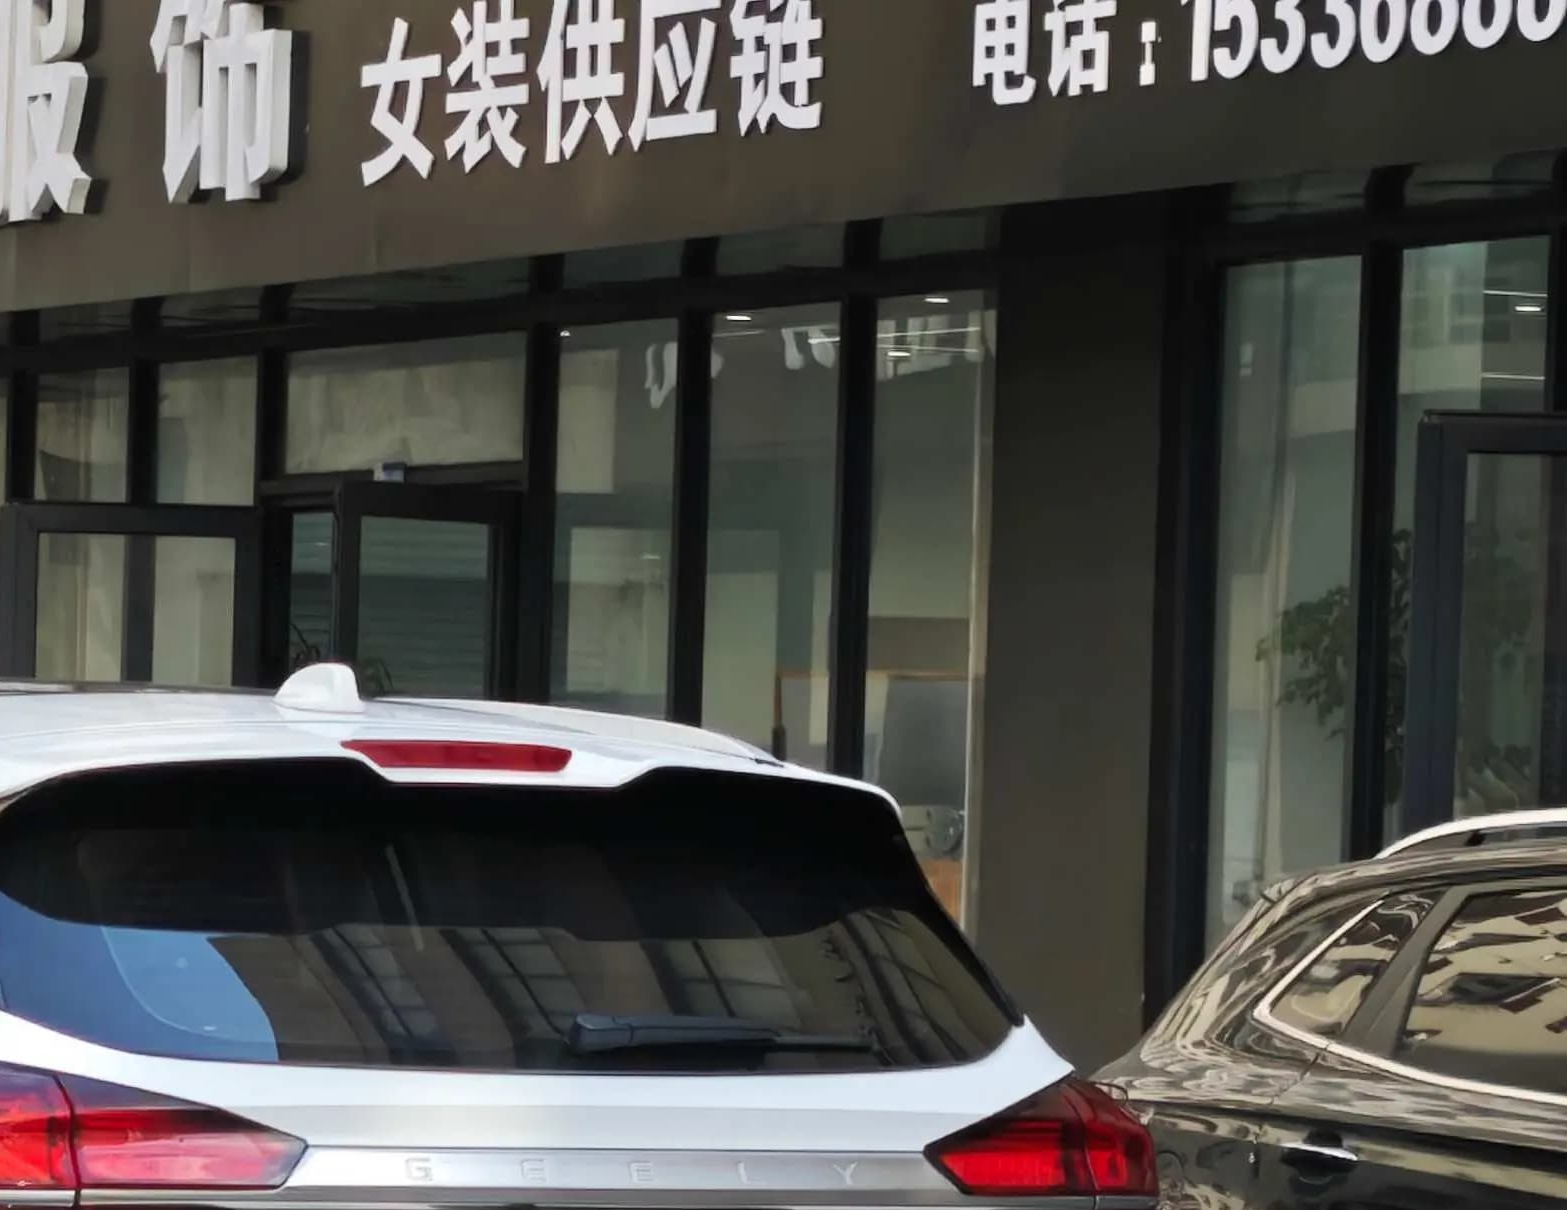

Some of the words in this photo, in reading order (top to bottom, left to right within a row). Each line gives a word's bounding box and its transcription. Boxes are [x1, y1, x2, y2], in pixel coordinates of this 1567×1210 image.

[360, 0, 823, 188] 女装供应链
[405, 1158, 858, 1185] GEELY
